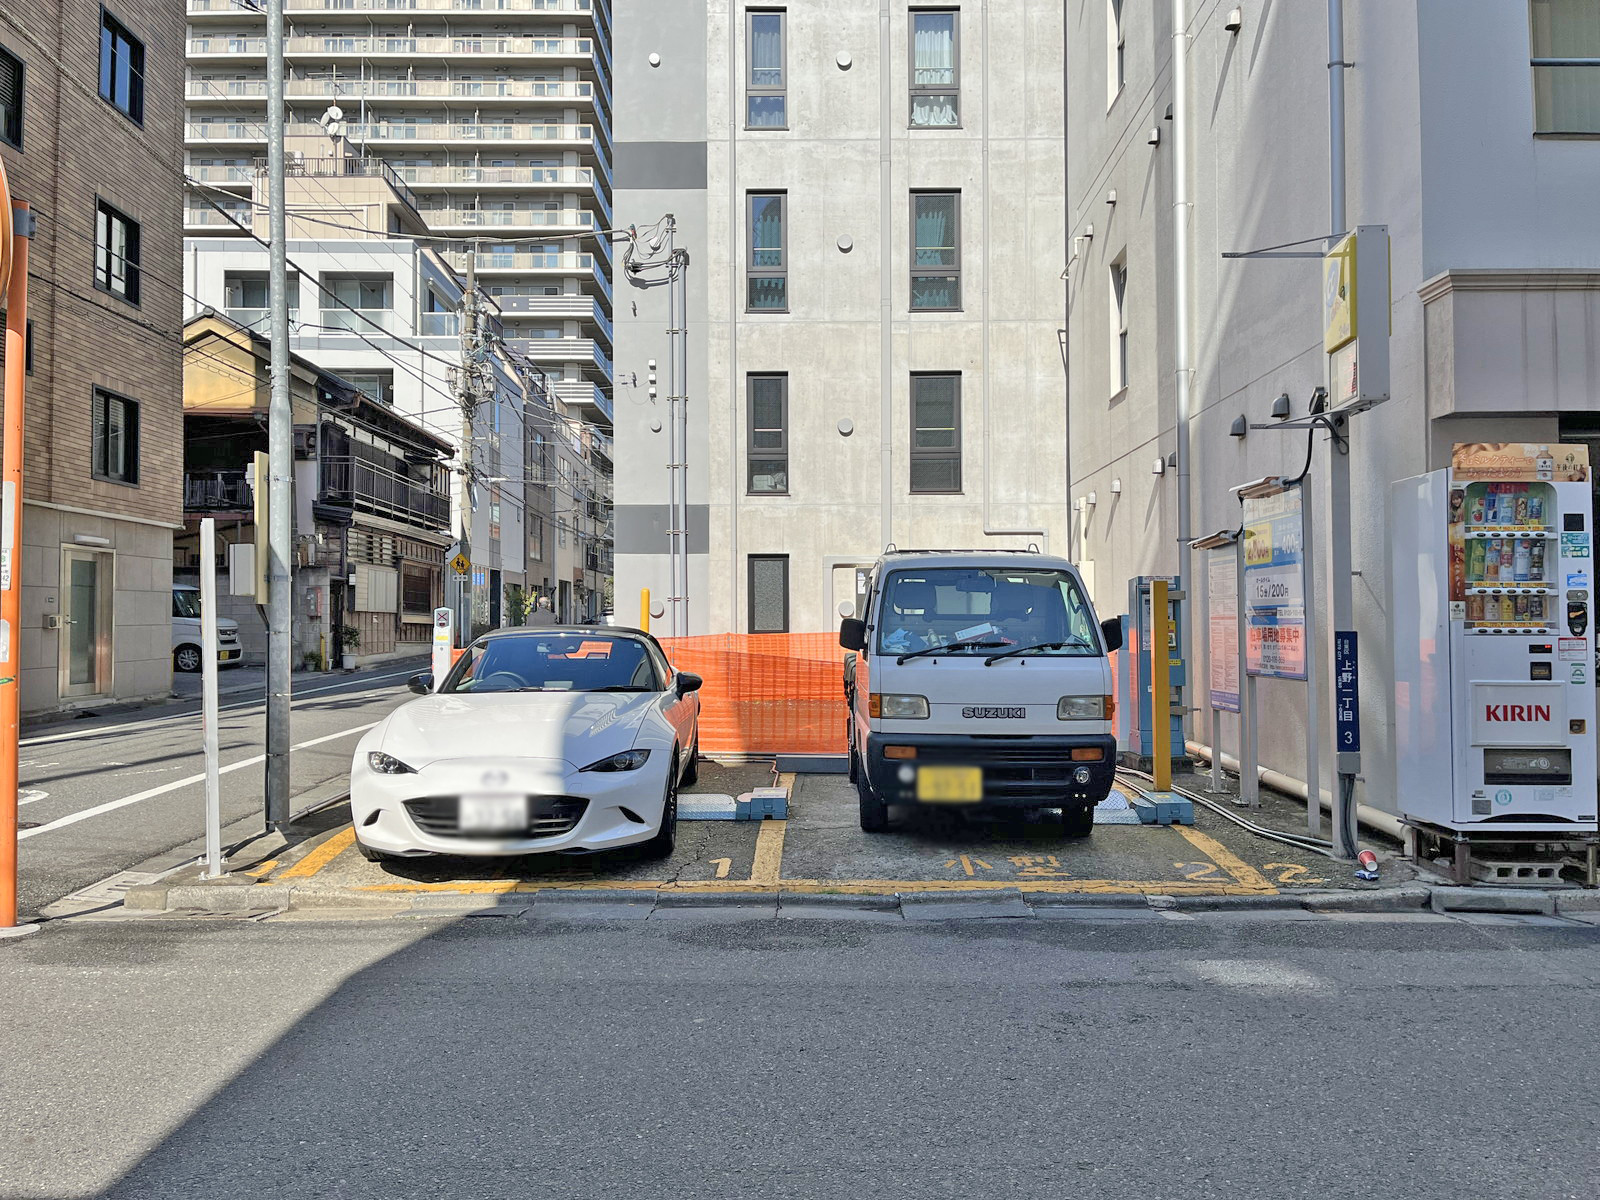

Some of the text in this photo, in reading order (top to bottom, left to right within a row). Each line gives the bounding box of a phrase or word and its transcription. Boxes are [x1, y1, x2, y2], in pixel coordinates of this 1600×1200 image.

[1341, 660, 1353, 721] 上野一丁目
[962, 707, 1026, 719] SUZUKI
[1486, 704, 1551, 721] KIRIN
[1344, 731, 1353, 744] 3
[708, 857, 733, 878] 1
[944, 854, 1072, 877] 小型
[1173, 862, 1230, 882] 2
[1264, 862, 1324, 883] 2
